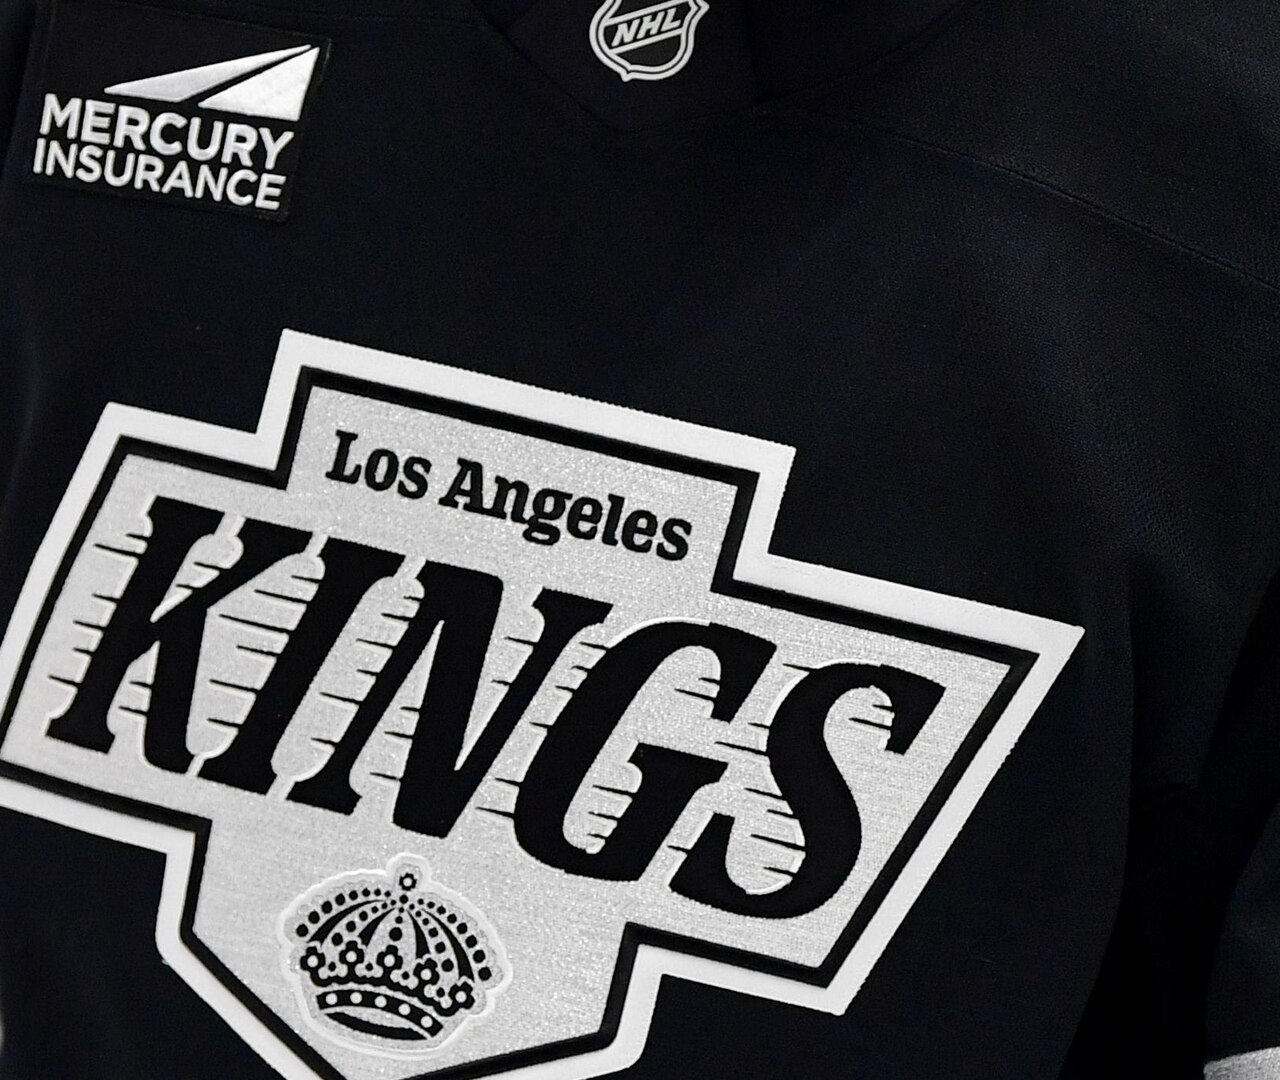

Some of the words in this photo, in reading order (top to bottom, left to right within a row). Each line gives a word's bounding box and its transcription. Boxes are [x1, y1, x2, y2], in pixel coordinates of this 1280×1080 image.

[611, 7, 682, 47] NHL
[38, 93, 295, 170] MERCURY
[33, 137, 287, 210] INSURANCE
[325, 429, 432, 500] Los
[438, 457, 693, 561] Angeles
[45, 495, 947, 920] KINGS
